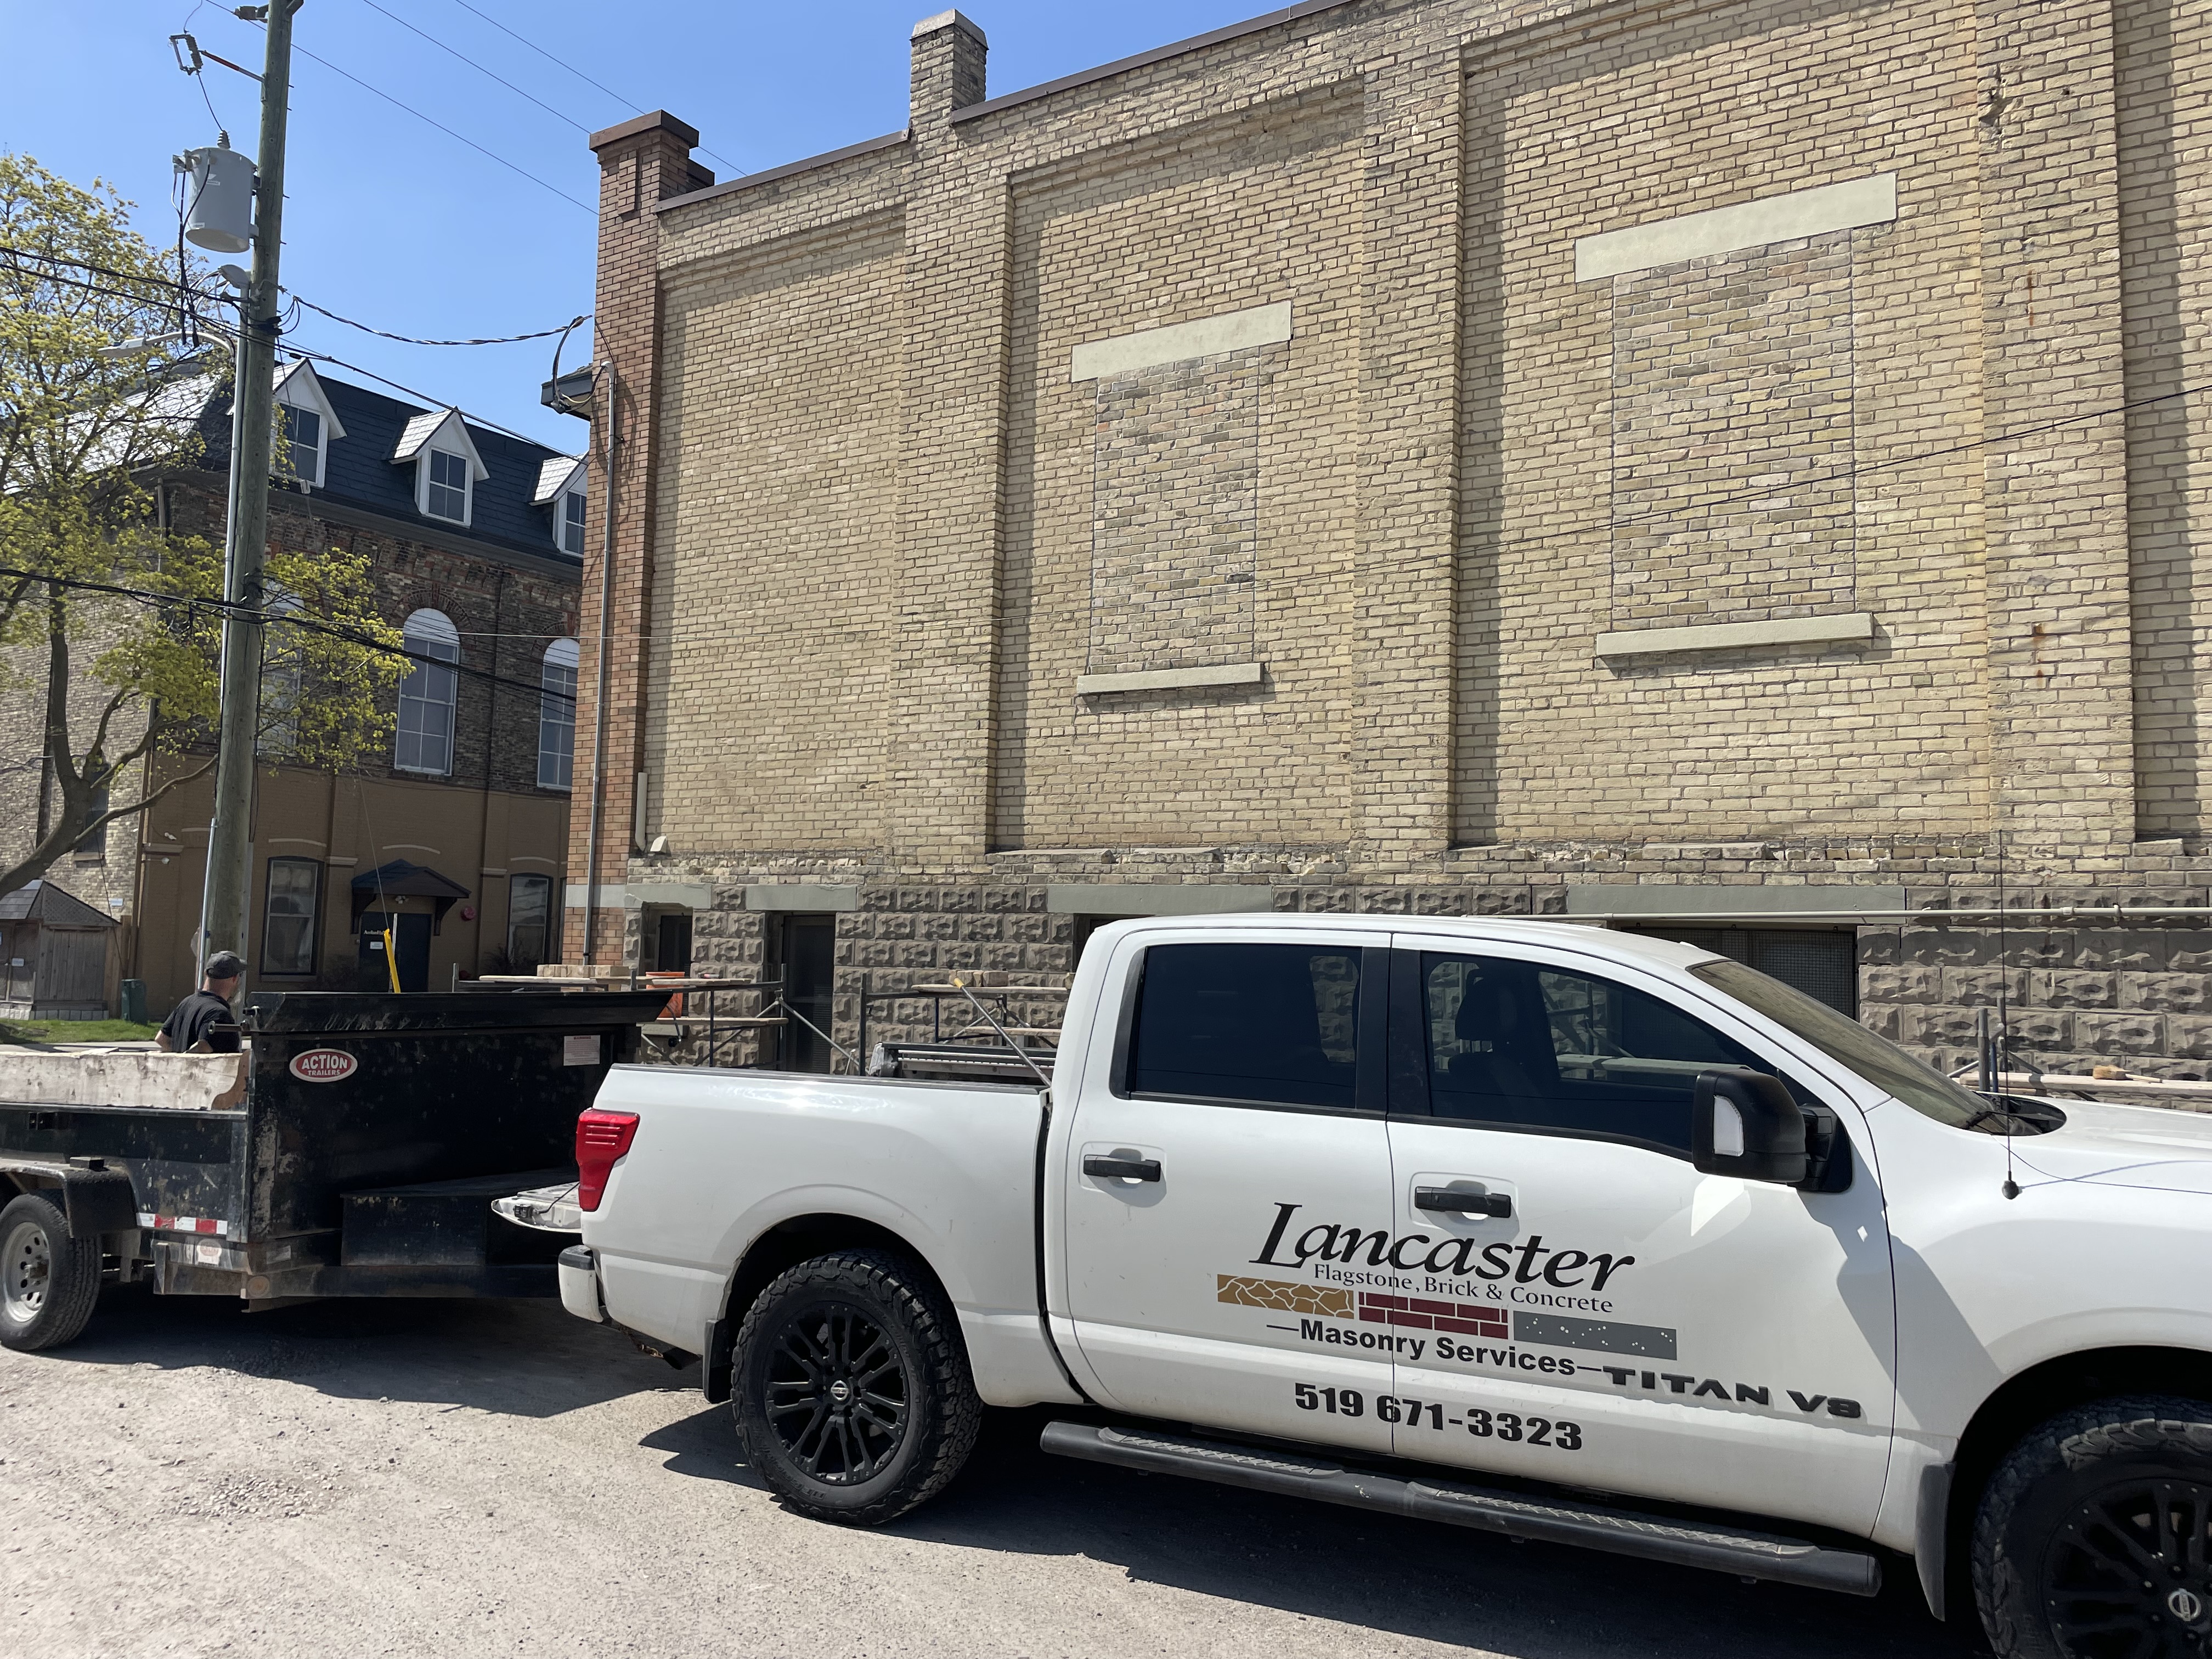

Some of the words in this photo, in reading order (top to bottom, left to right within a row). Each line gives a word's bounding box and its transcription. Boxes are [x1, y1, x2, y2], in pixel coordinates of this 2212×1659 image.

[301, 1054, 348, 1070] ACTION
[1249, 1202, 1635, 1291] Lancaster
[1314, 1263, 1420, 1293] Flagstone,
[1425, 1276, 1480, 1298] Brick
[1486, 1284, 1503, 1300] &
[1510, 1286, 1613, 1313] Concrete
[1301, 1319, 1426, 1361] Masonry
[1436, 1337, 1576, 1376] Services
[1295, 1383, 1364, 1417] 519
[1376, 1395, 1582, 1451] 671-3323
[1602, 1365, 1769, 1406] TITAN
[1786, 1390, 1861, 1418] V8
